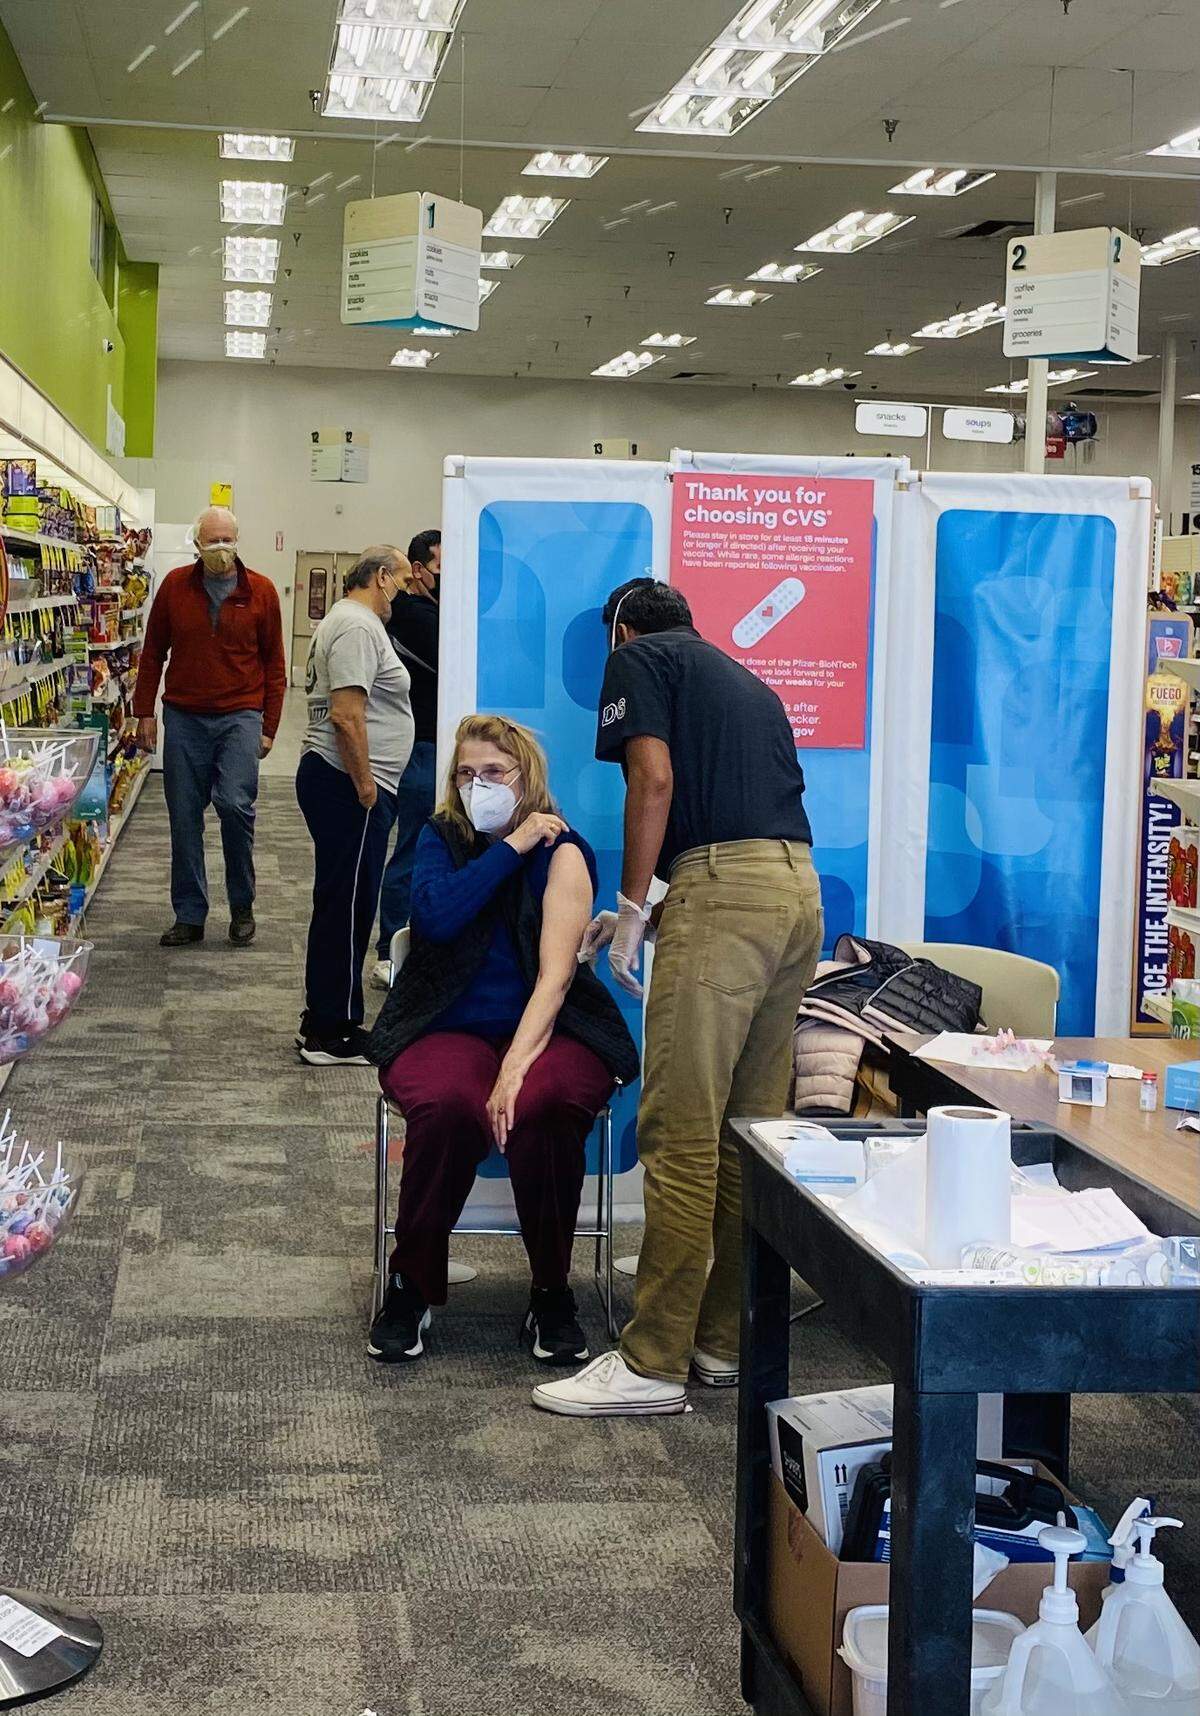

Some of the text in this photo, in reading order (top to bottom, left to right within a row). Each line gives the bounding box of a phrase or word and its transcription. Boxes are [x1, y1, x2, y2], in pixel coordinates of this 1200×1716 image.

[427, 203, 436, 229] 1
[1114, 236, 1122, 263] 2
[1012, 244, 1027, 270] 2
[1014, 282, 1035, 292] coffee
[1013, 306, 1033, 315] cereal
[1012, 330, 1042, 340] groceries
[876, 412, 906, 421] snacks
[965, 420, 992, 428] soups
[686, 482, 826, 506] Thank you for
[684, 505, 778, 529] choosing
[683, 530, 710, 539] Please
[711, 532, 728, 541] stay
[738, 532, 759, 540] store
[760, 533, 772, 541] for
[814, 535, 848, 544] minutes
[683, 540, 694, 549] (or
[696, 540, 722, 550] longer
[730, 542, 766, 551] directed)
[788, 544, 826, 554] receiving
[717, 550, 740, 558] While
[785, 554, 815, 563] allergic
[816, 555, 854, 563] reactions
[724, 561, 759, 570] reported
[761, 562, 797, 572] following
[799, 564, 846, 572] vaccination.
[747, 658, 766, 666] dose
[768, 658, 777, 666] of
[778, 659, 791, 667] the
[793, 659, 857, 670] Pfizer-BioNTech
[793, 669, 825, 677] forward
[785, 678, 813, 686] weeks
[1150, 687, 1181, 699] FUEGO
[793, 702, 819, 712] after
[787, 715, 821, 724] ecker.
[1146, 803, 1173, 912] INTENSITY!
[1144, 918, 1168, 956] THE
